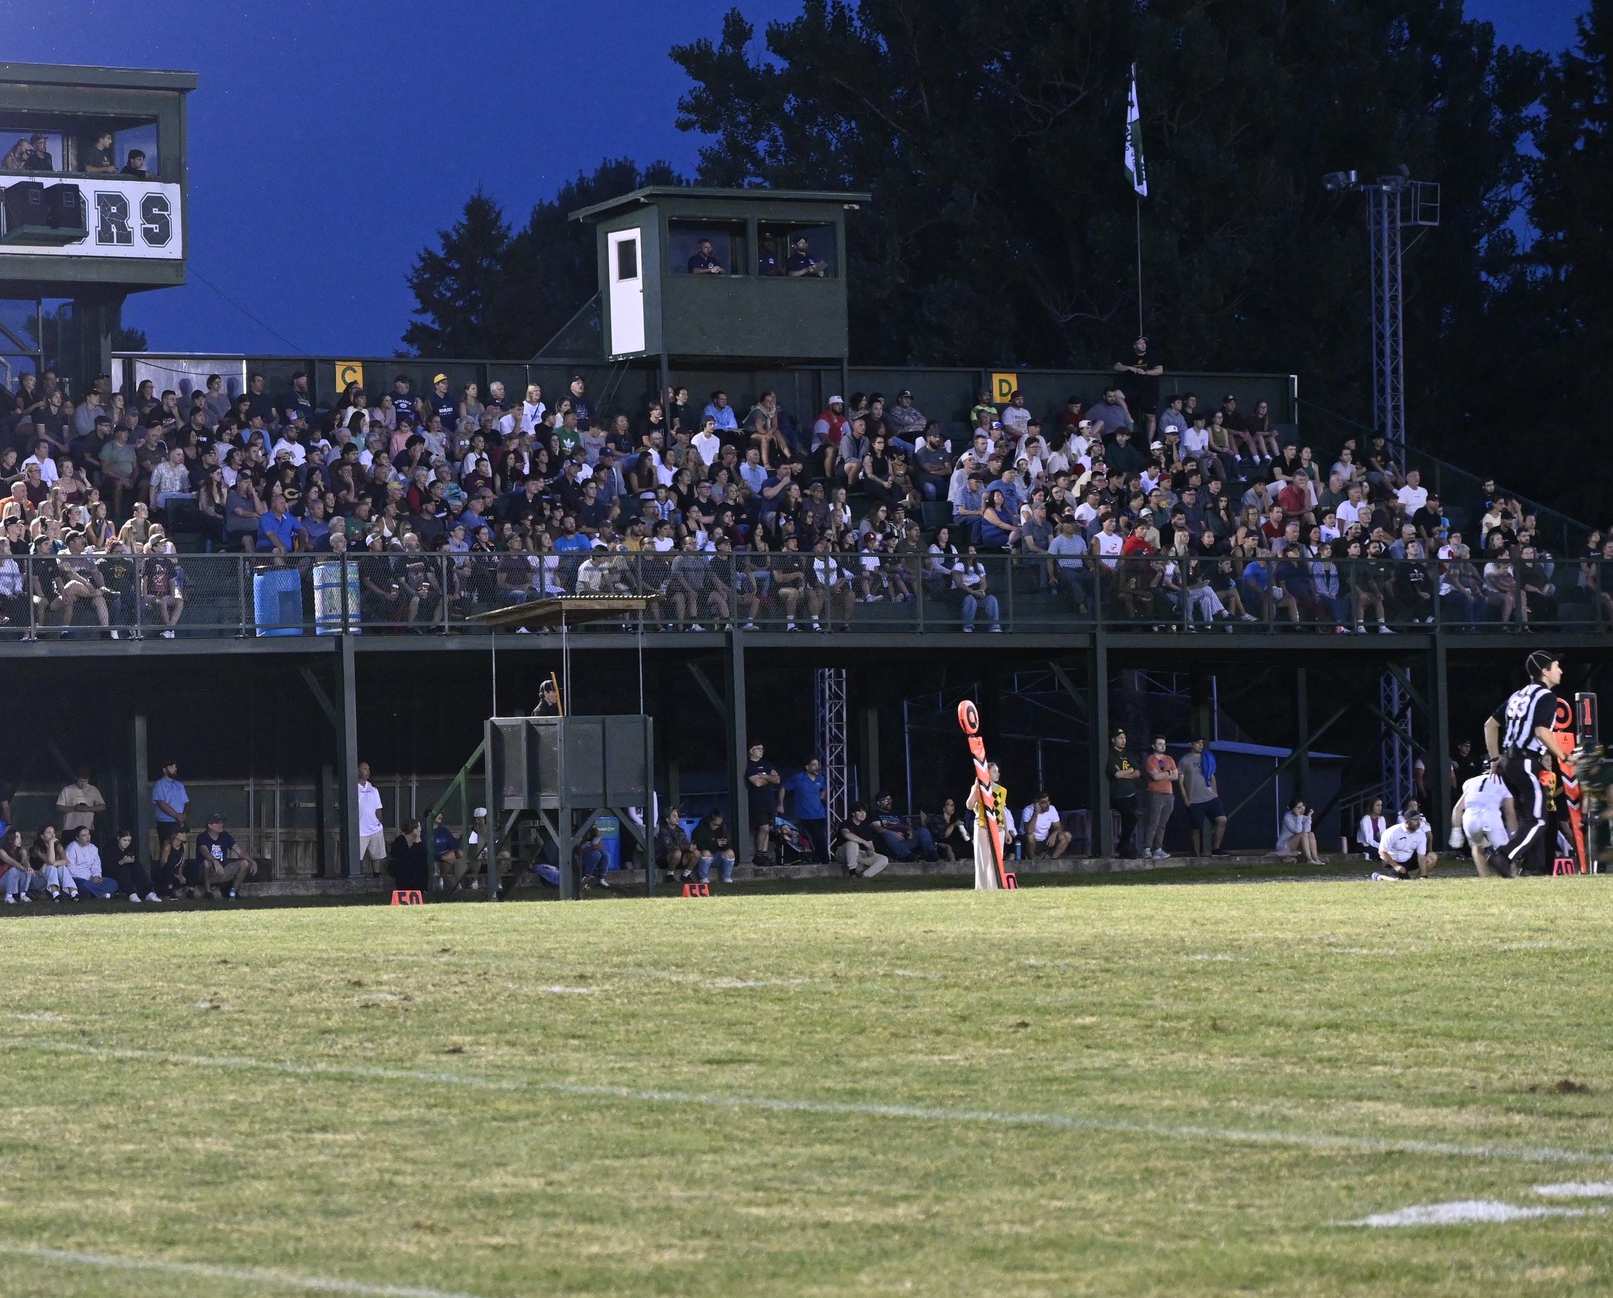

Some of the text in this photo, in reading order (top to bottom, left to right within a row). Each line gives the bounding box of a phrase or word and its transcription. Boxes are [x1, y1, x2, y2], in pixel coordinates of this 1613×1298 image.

[341, 366, 358, 387] C
[998, 378, 1013, 398] D
[1507, 696, 1531, 718] 93
[1583, 697, 1592, 725] 1
[1555, 859, 1575, 875] 40
[398, 891, 420, 905] 50
[689, 884, 708, 897] 55
